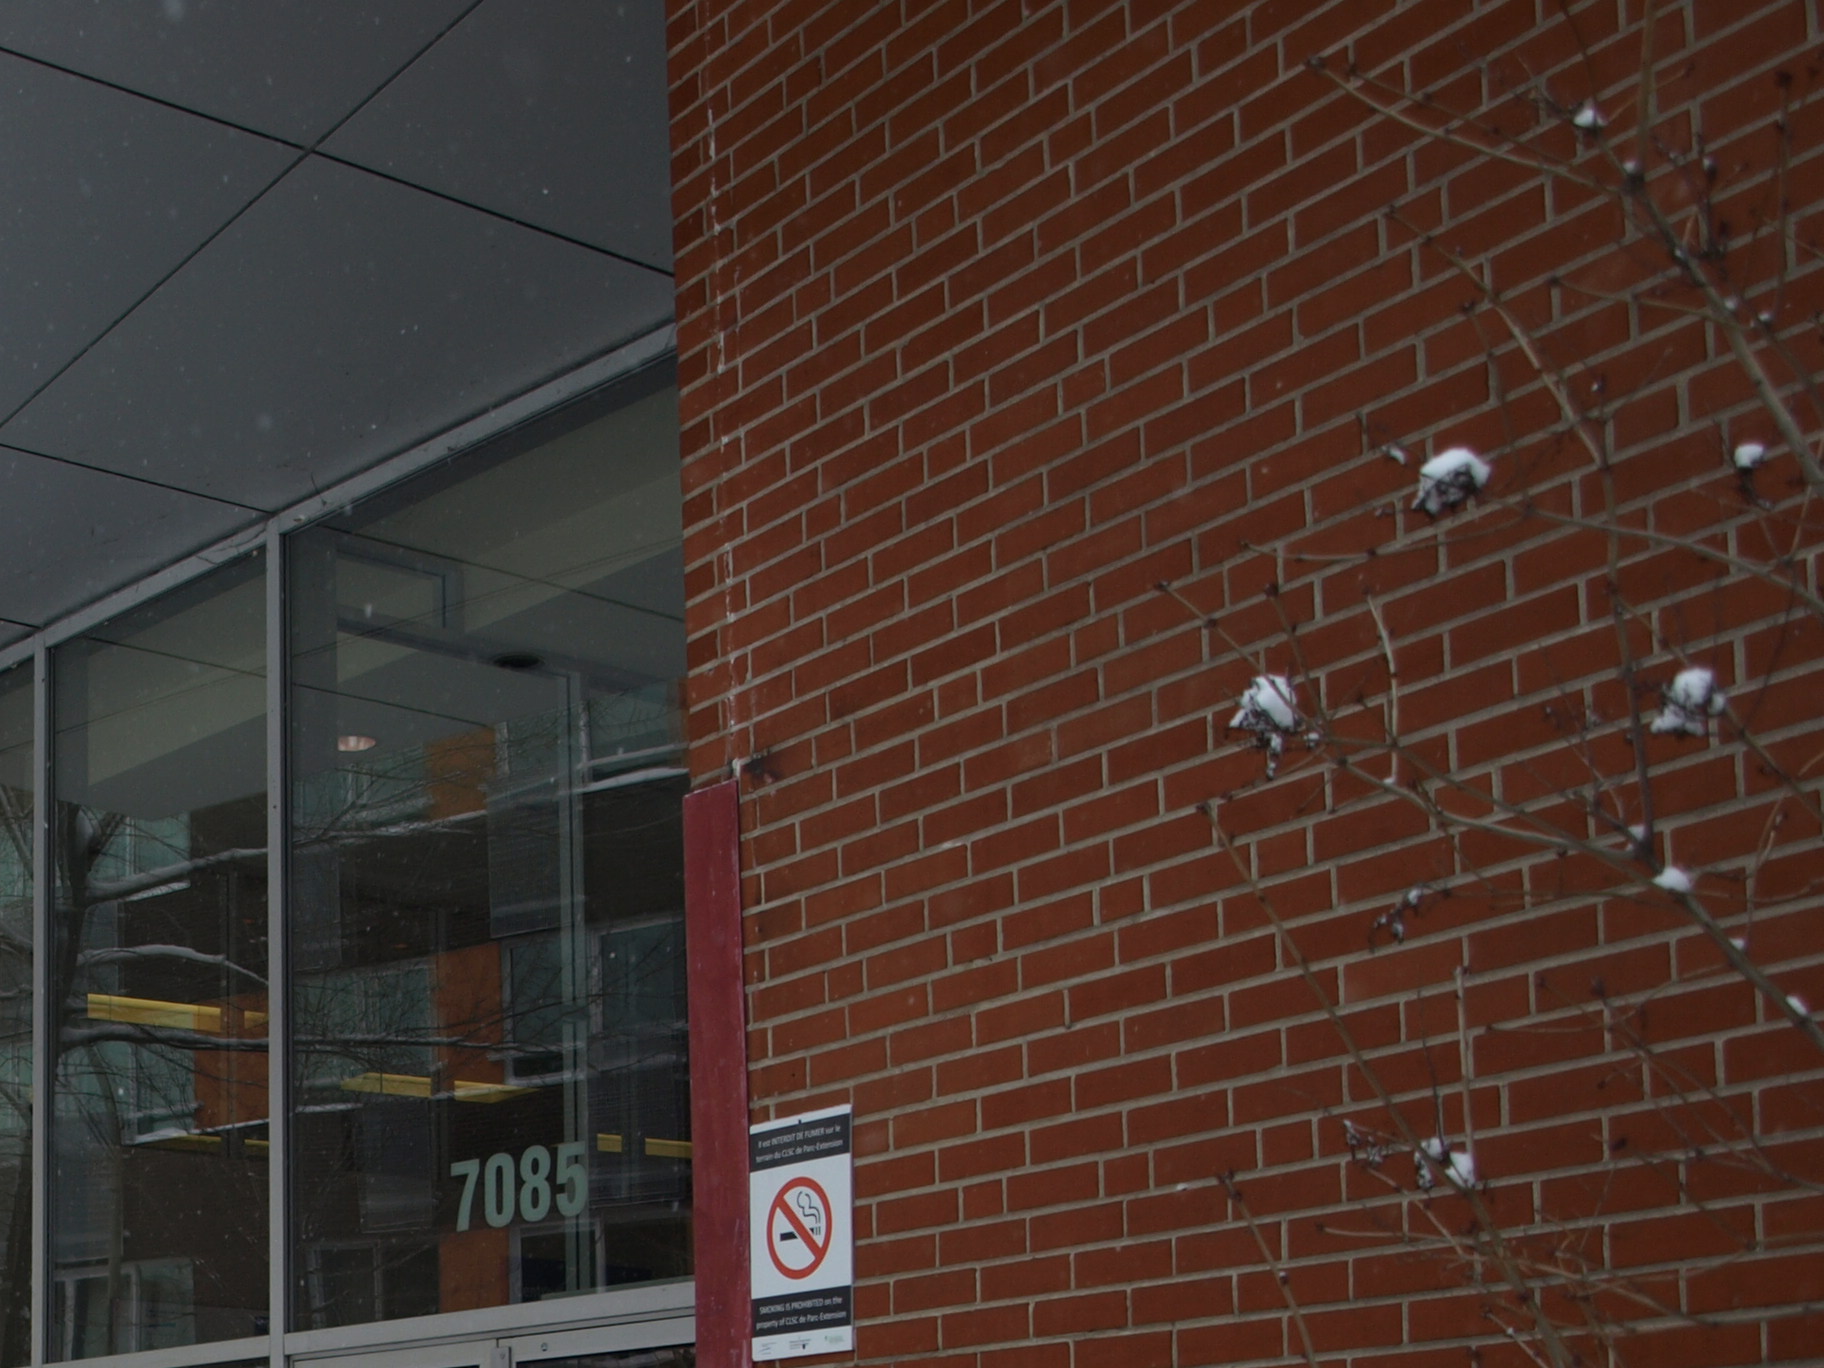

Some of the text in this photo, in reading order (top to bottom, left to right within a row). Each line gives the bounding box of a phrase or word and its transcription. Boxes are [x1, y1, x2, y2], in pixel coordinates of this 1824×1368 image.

[771, 1133, 796, 1145] INTERDIT
[796, 1131, 804, 1140] DE
[804, 1127, 825, 1138] FUMER
[782, 1149, 794, 1158] CLSC
[803, 1139, 844, 1153] Parc-Extension
[450, 1141, 589, 1233] 7085
[760, 1303, 785, 1315] SMOKING
[792, 1298, 824, 1310] PROHIBITED
[785, 1316, 798, 1326] CLSC
[806, 1311, 847, 1323] Parc-Extension
